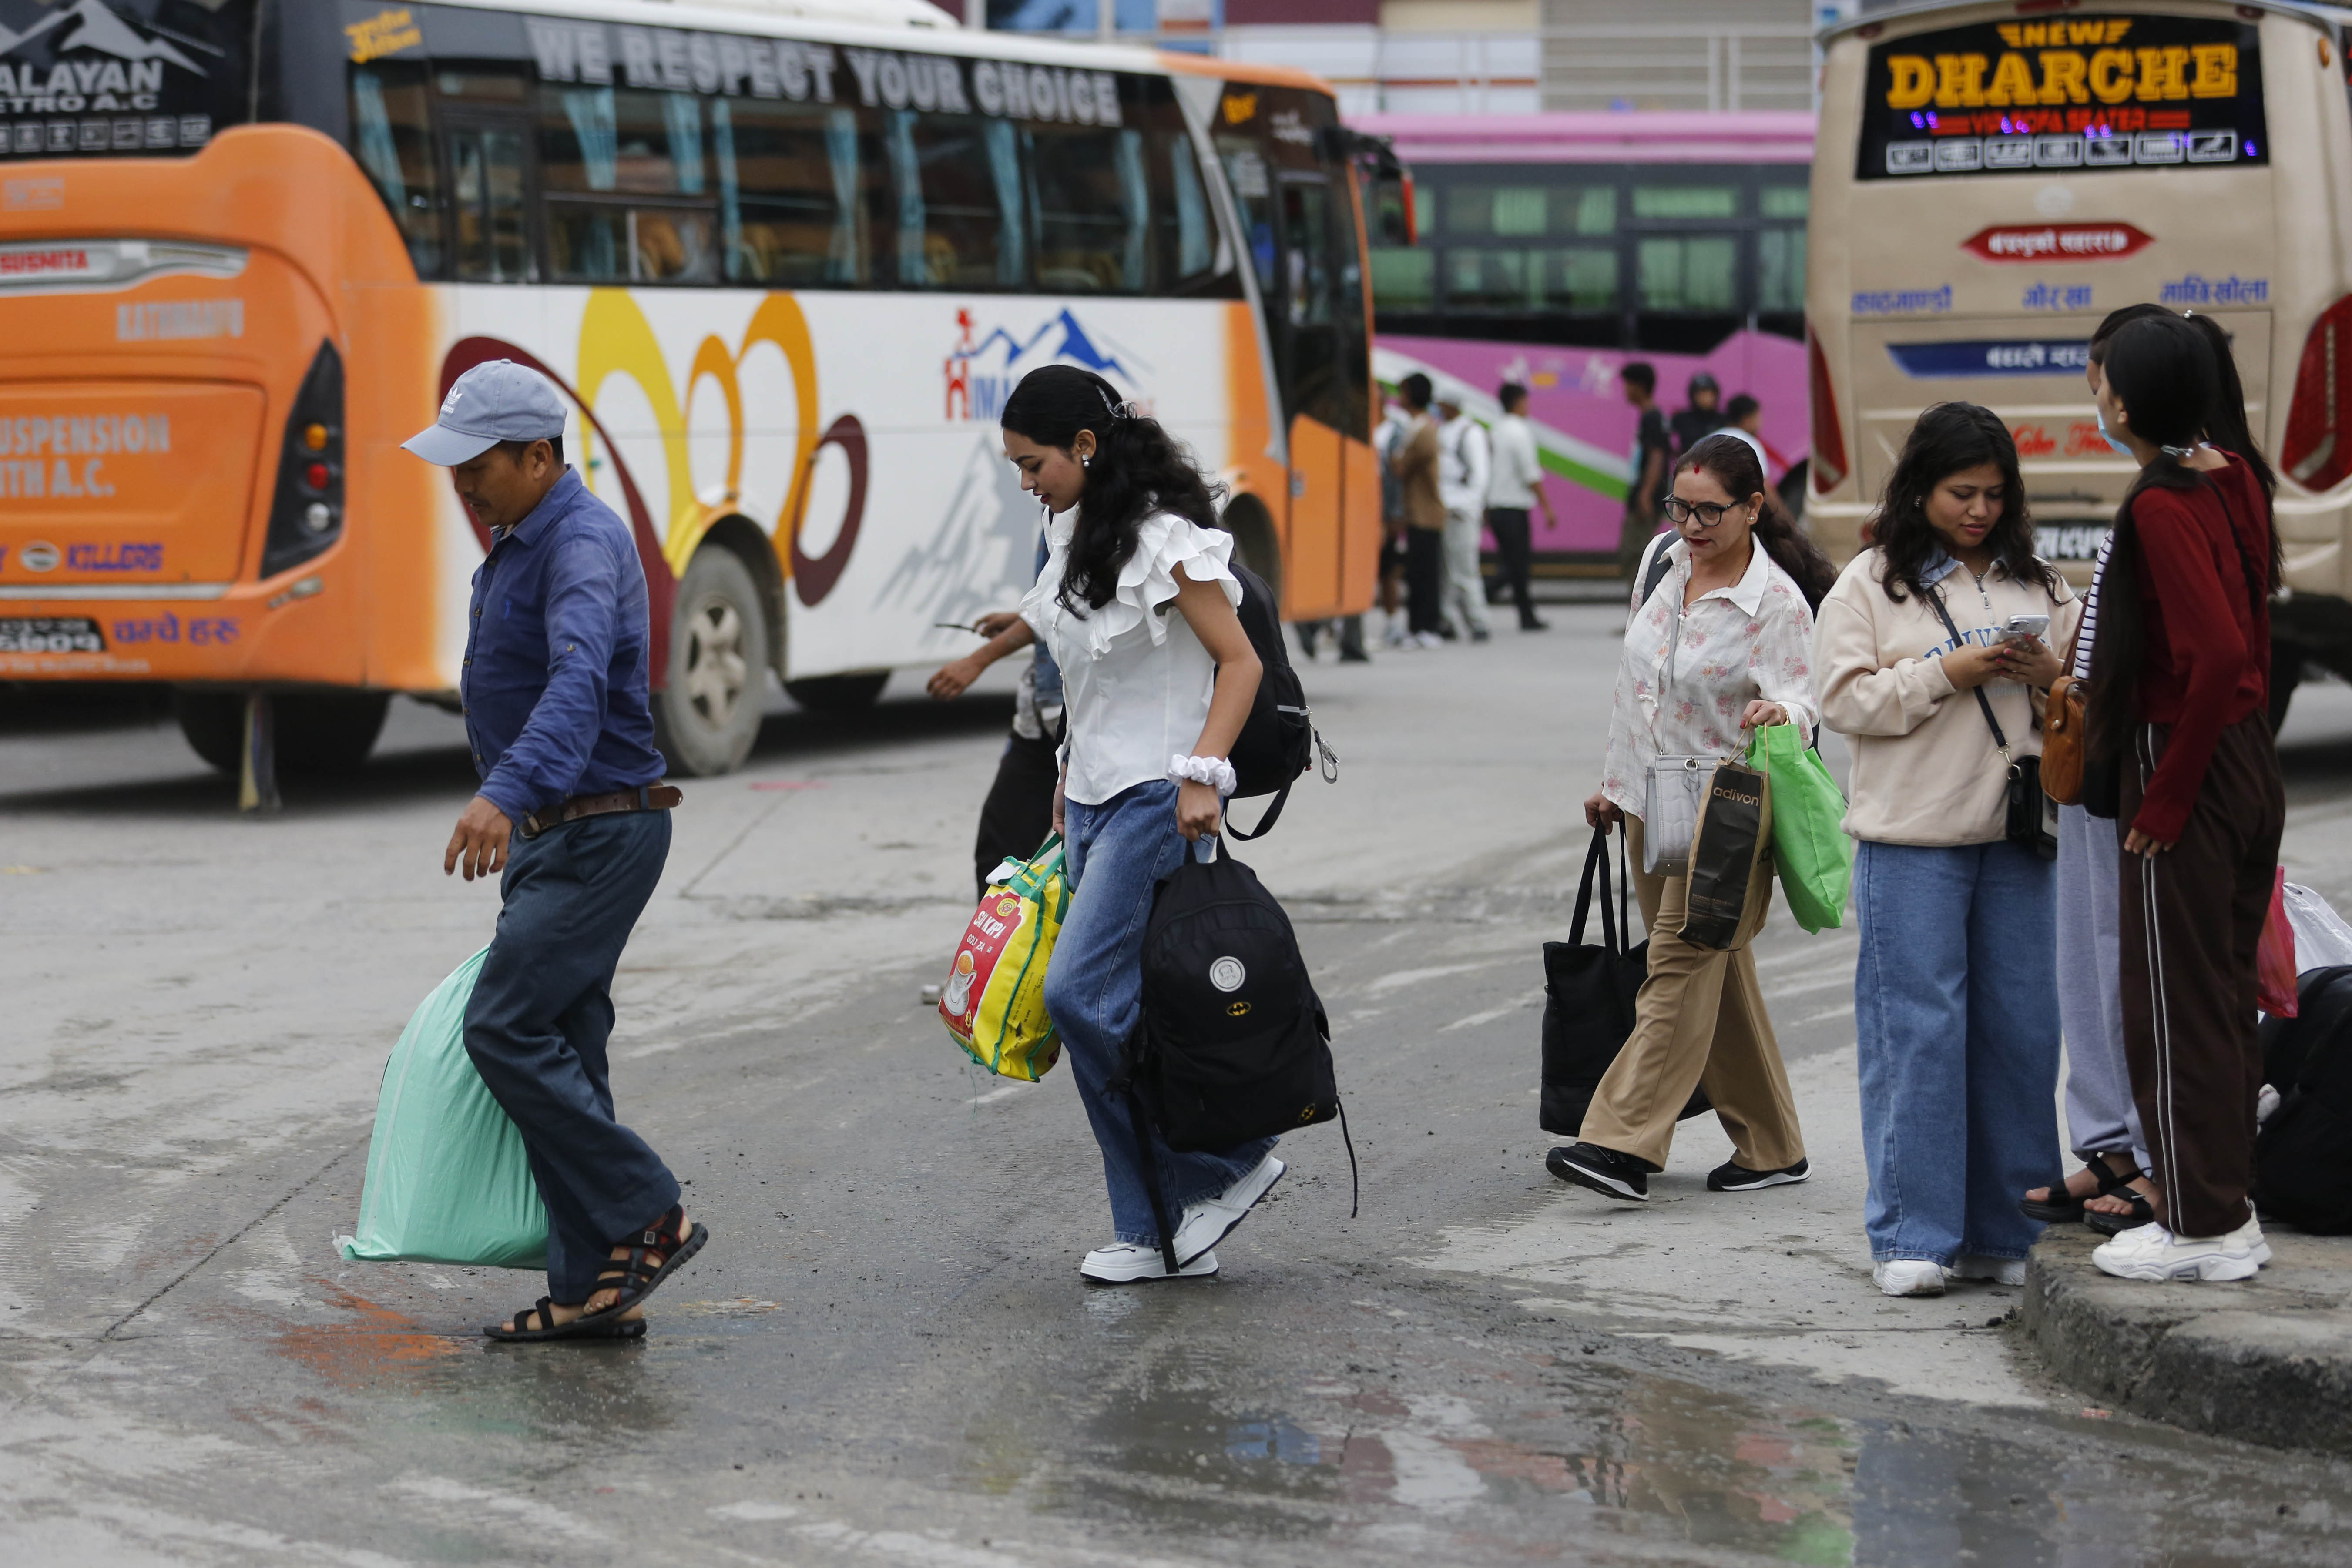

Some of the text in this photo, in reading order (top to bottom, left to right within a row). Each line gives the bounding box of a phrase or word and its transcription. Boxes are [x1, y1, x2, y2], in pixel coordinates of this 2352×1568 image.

[2022, 21, 2105, 46] NEW
[525, 20, 1124, 127] WE RESPECT YOUR CHOICE
[1887, 45, 2238, 108] DHARCHE
[1713, 787, 1759, 806] adivon
